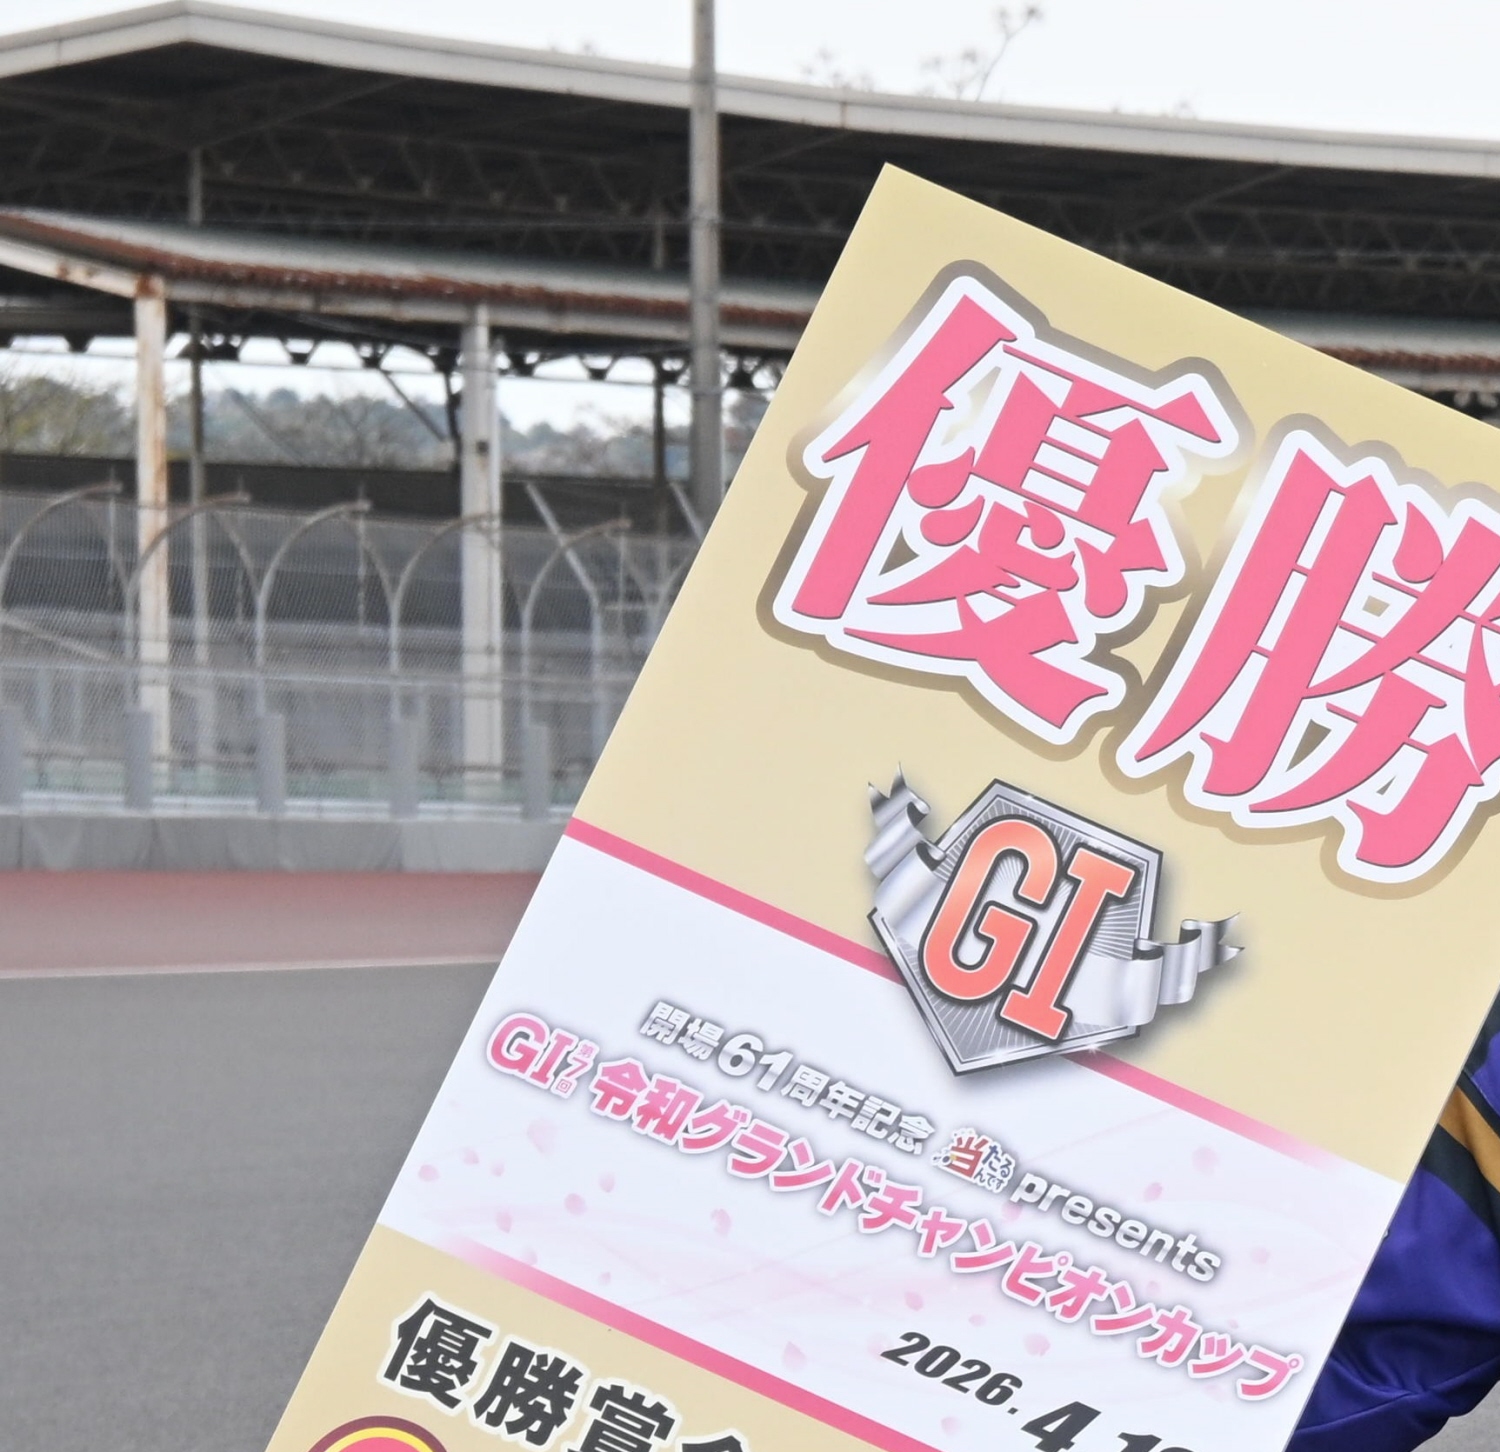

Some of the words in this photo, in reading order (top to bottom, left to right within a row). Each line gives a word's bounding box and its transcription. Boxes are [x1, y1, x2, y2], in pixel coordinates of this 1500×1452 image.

[919, 821, 1136, 1042] GI
[590, 1058, 1304, 1399] 令和グランドチャンピオンカップ
[640, 1001, 936, 1155] 開場61周年記念
[1010, 1171, 1221, 1282] presents
[879, 1331, 1023, 1415] 2026.
